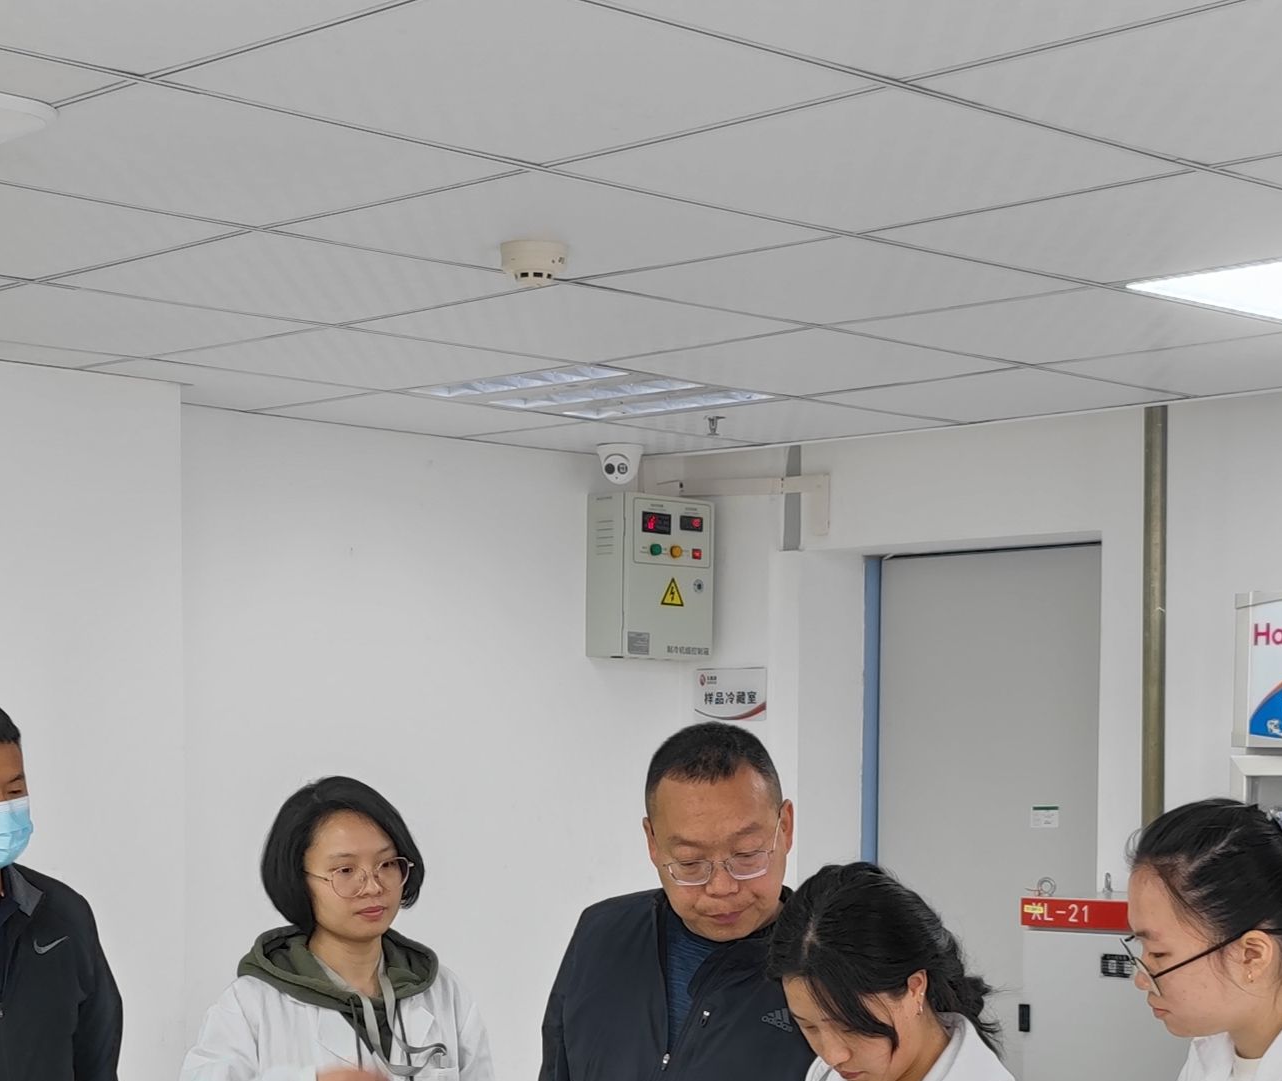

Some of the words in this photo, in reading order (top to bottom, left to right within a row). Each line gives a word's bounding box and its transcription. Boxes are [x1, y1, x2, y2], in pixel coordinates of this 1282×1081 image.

[704, 691, 757, 705] 样品冷藏室
